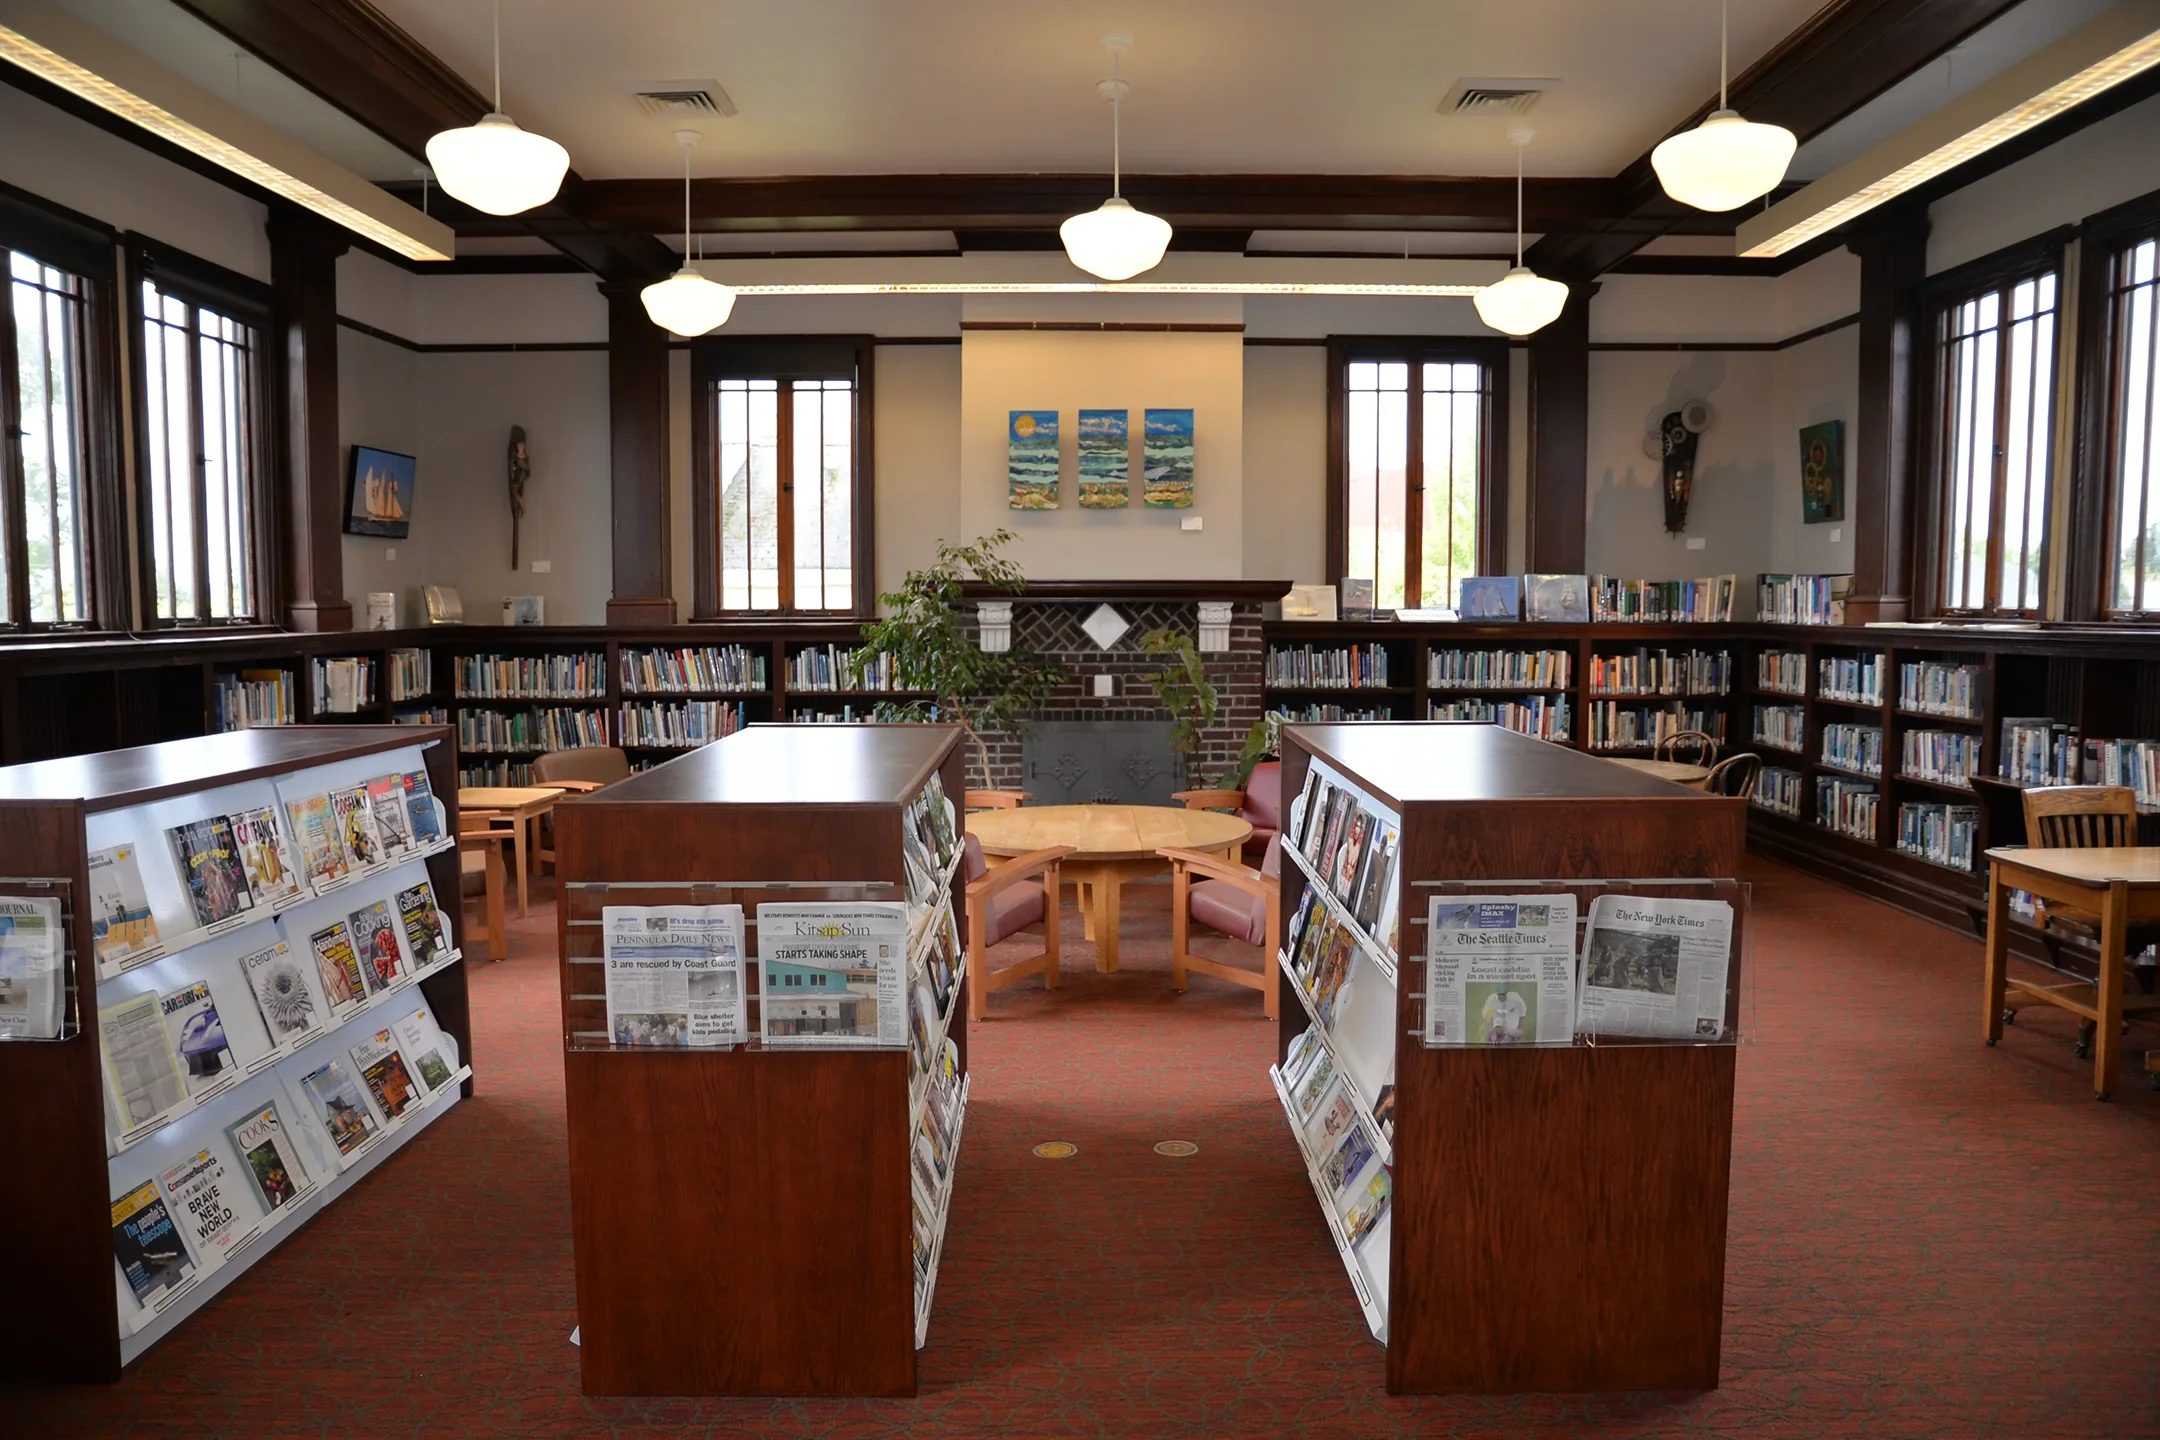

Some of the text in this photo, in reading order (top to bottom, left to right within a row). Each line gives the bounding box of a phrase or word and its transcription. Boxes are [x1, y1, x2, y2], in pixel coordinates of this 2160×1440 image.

[197, 820, 230, 838] appit
[354, 912, 390, 937] Cooking
[1616, 910, 1704, 927] The New York Times
[616, 934, 730, 944] PENINSULA DAILY NEWS
[794, 922, 870, 940] Kitsap Sun
[1457, 932, 1546, 945] The Seattle Times
[314, 932, 348, 952] Handyman
[776, 950, 867, 959] STARTS TAKING SHAPE
[611, 960, 617, 968] 3
[637, 960, 670, 968] rescued
[672, 960, 682, 970] by
[684, 960, 708, 968] Coast
[711, 959, 736, 968] Guard
[161, 998, 178, 1016] CAR
[707, 1028, 737, 1036] pedaling
[722, 1020, 733, 1028] get
[238, 1118, 279, 1150] COOKS
[187, 1184, 220, 1214] BRAVE
[199, 1200, 220, 1222] NEW
[124, 1204, 166, 1239] The people's
[197, 1208, 232, 1239] WORLD
[138, 1218, 172, 1247] telescope
[200, 1241, 207, 1249] OF
[207, 1230, 222, 1244] SMART
